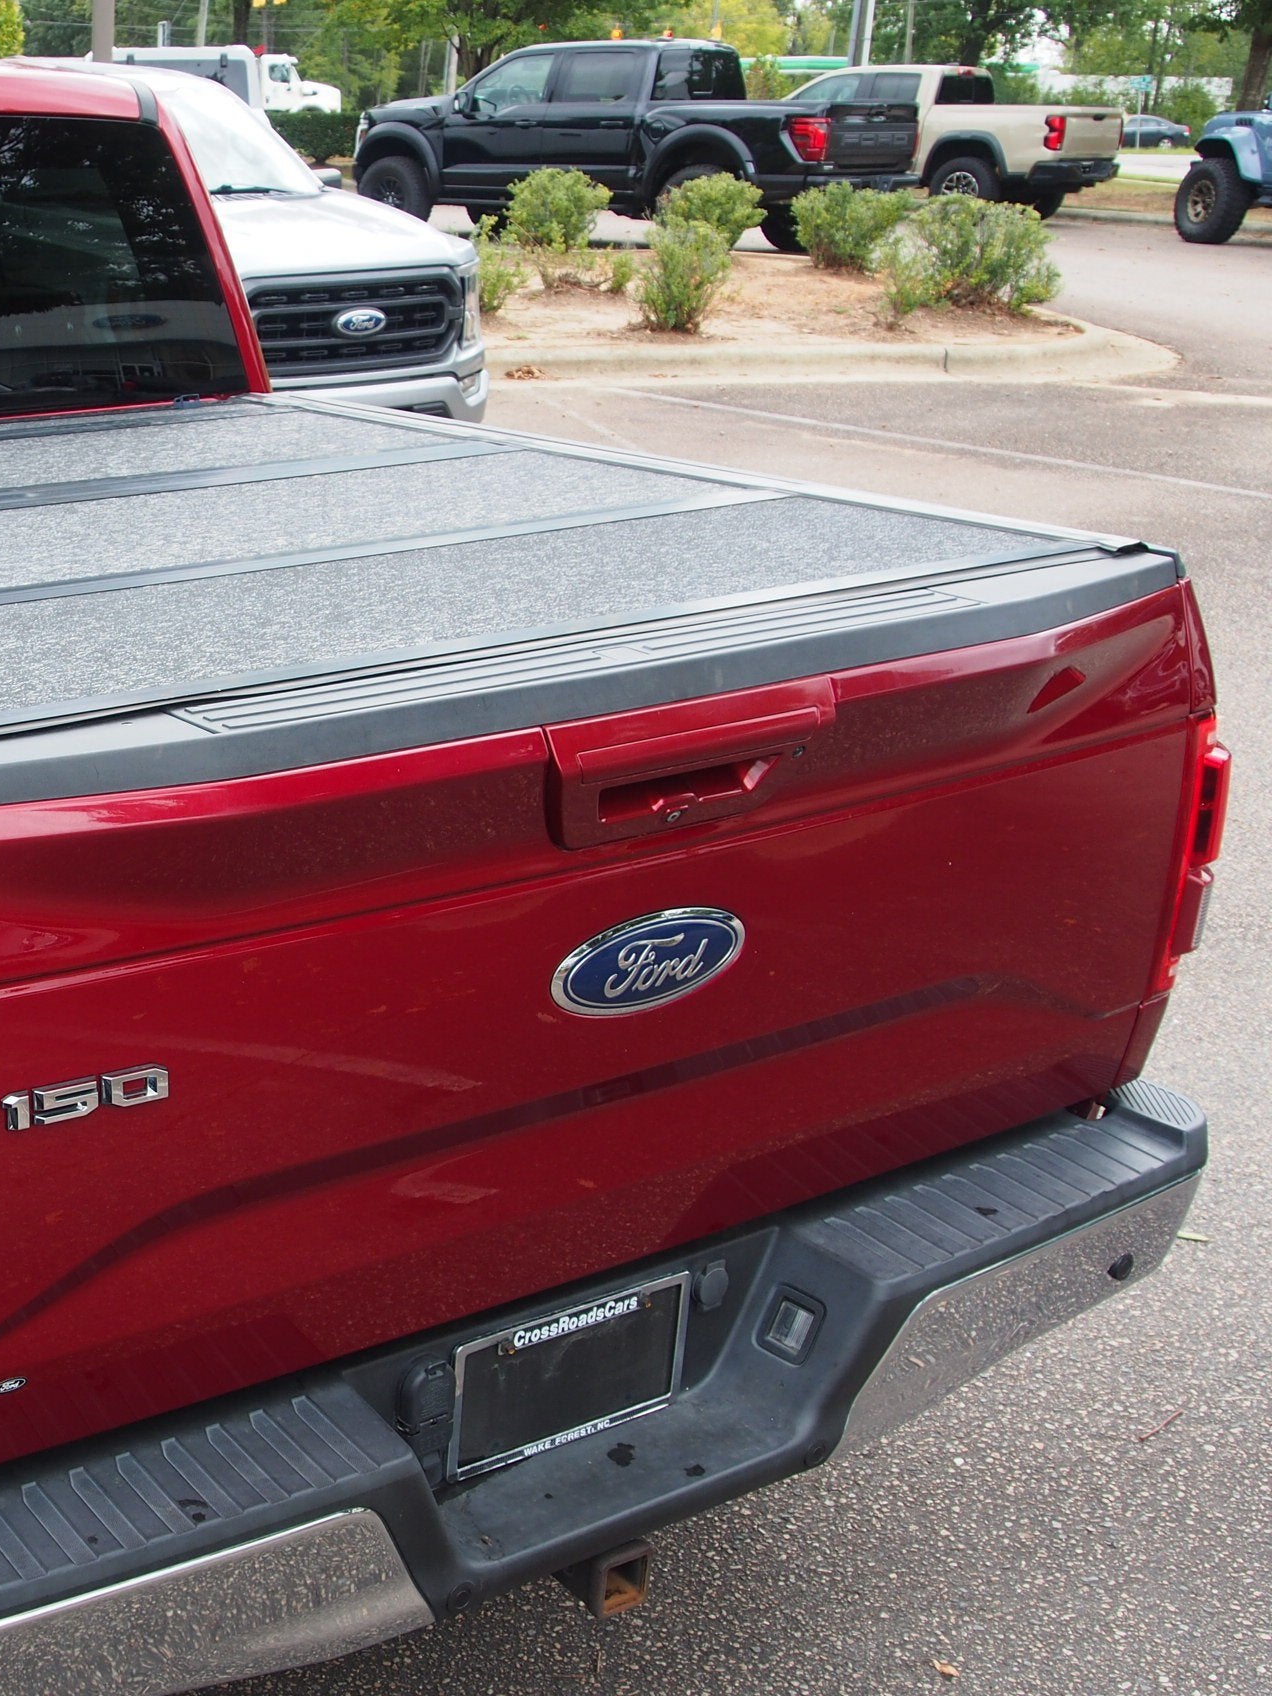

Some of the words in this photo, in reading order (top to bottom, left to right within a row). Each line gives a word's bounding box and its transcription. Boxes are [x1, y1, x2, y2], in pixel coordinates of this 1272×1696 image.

[349, 315, 376, 331] Ford
[604, 932, 709, 999] Ford
[513, 1296, 638, 1347] CrossRoadsCars
[523, 1440, 551, 1457] WAKE
[597, 1419, 611, 1431] NC
